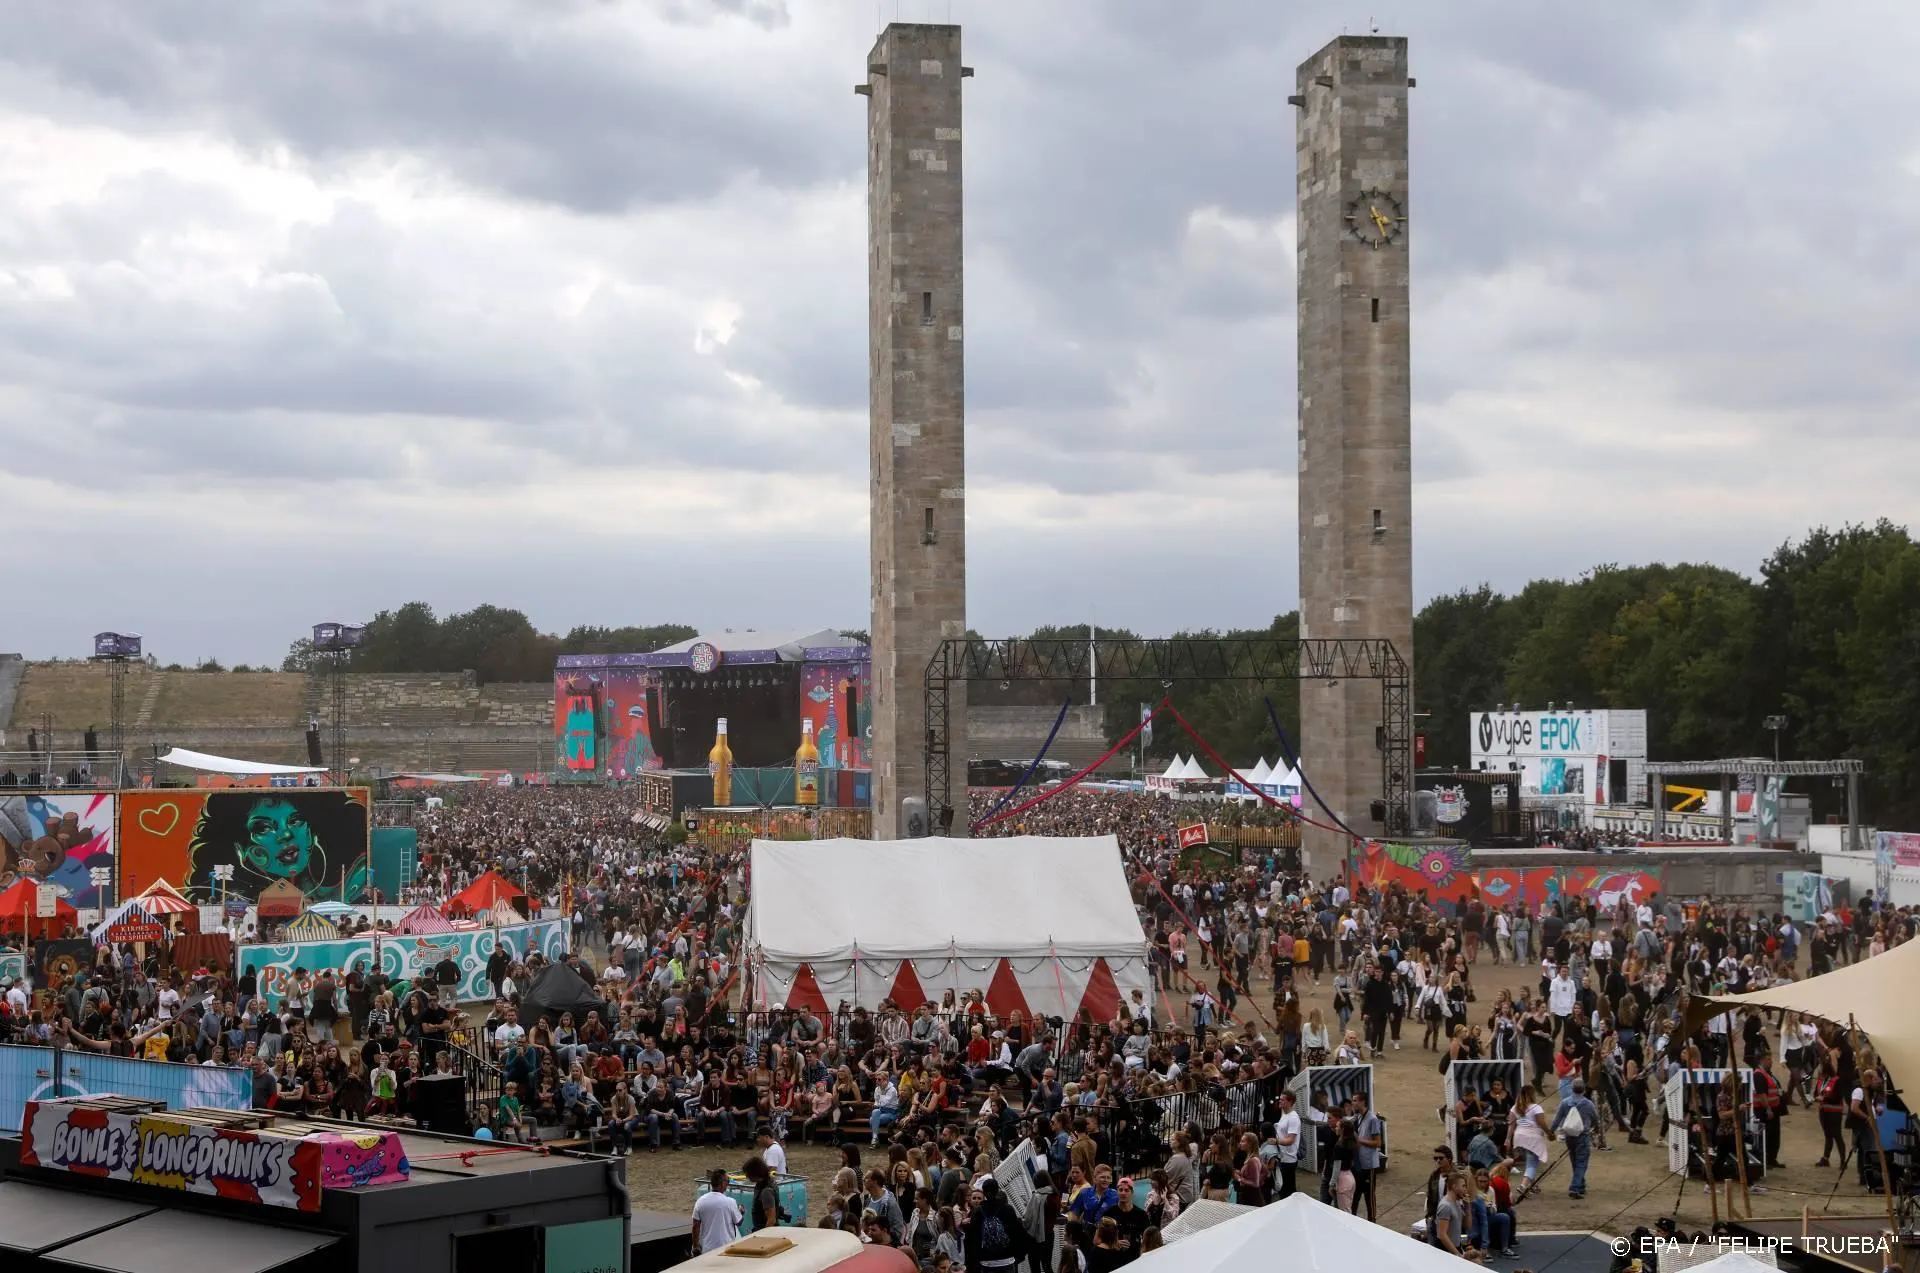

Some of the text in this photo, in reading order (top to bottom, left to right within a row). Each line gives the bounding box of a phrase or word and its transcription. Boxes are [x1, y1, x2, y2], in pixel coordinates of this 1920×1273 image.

[1494, 719, 1532, 755] vype
[1540, 717, 1580, 750] EPOK
[53, 1120, 283, 1187] BOWLE & LONGDRINKS
